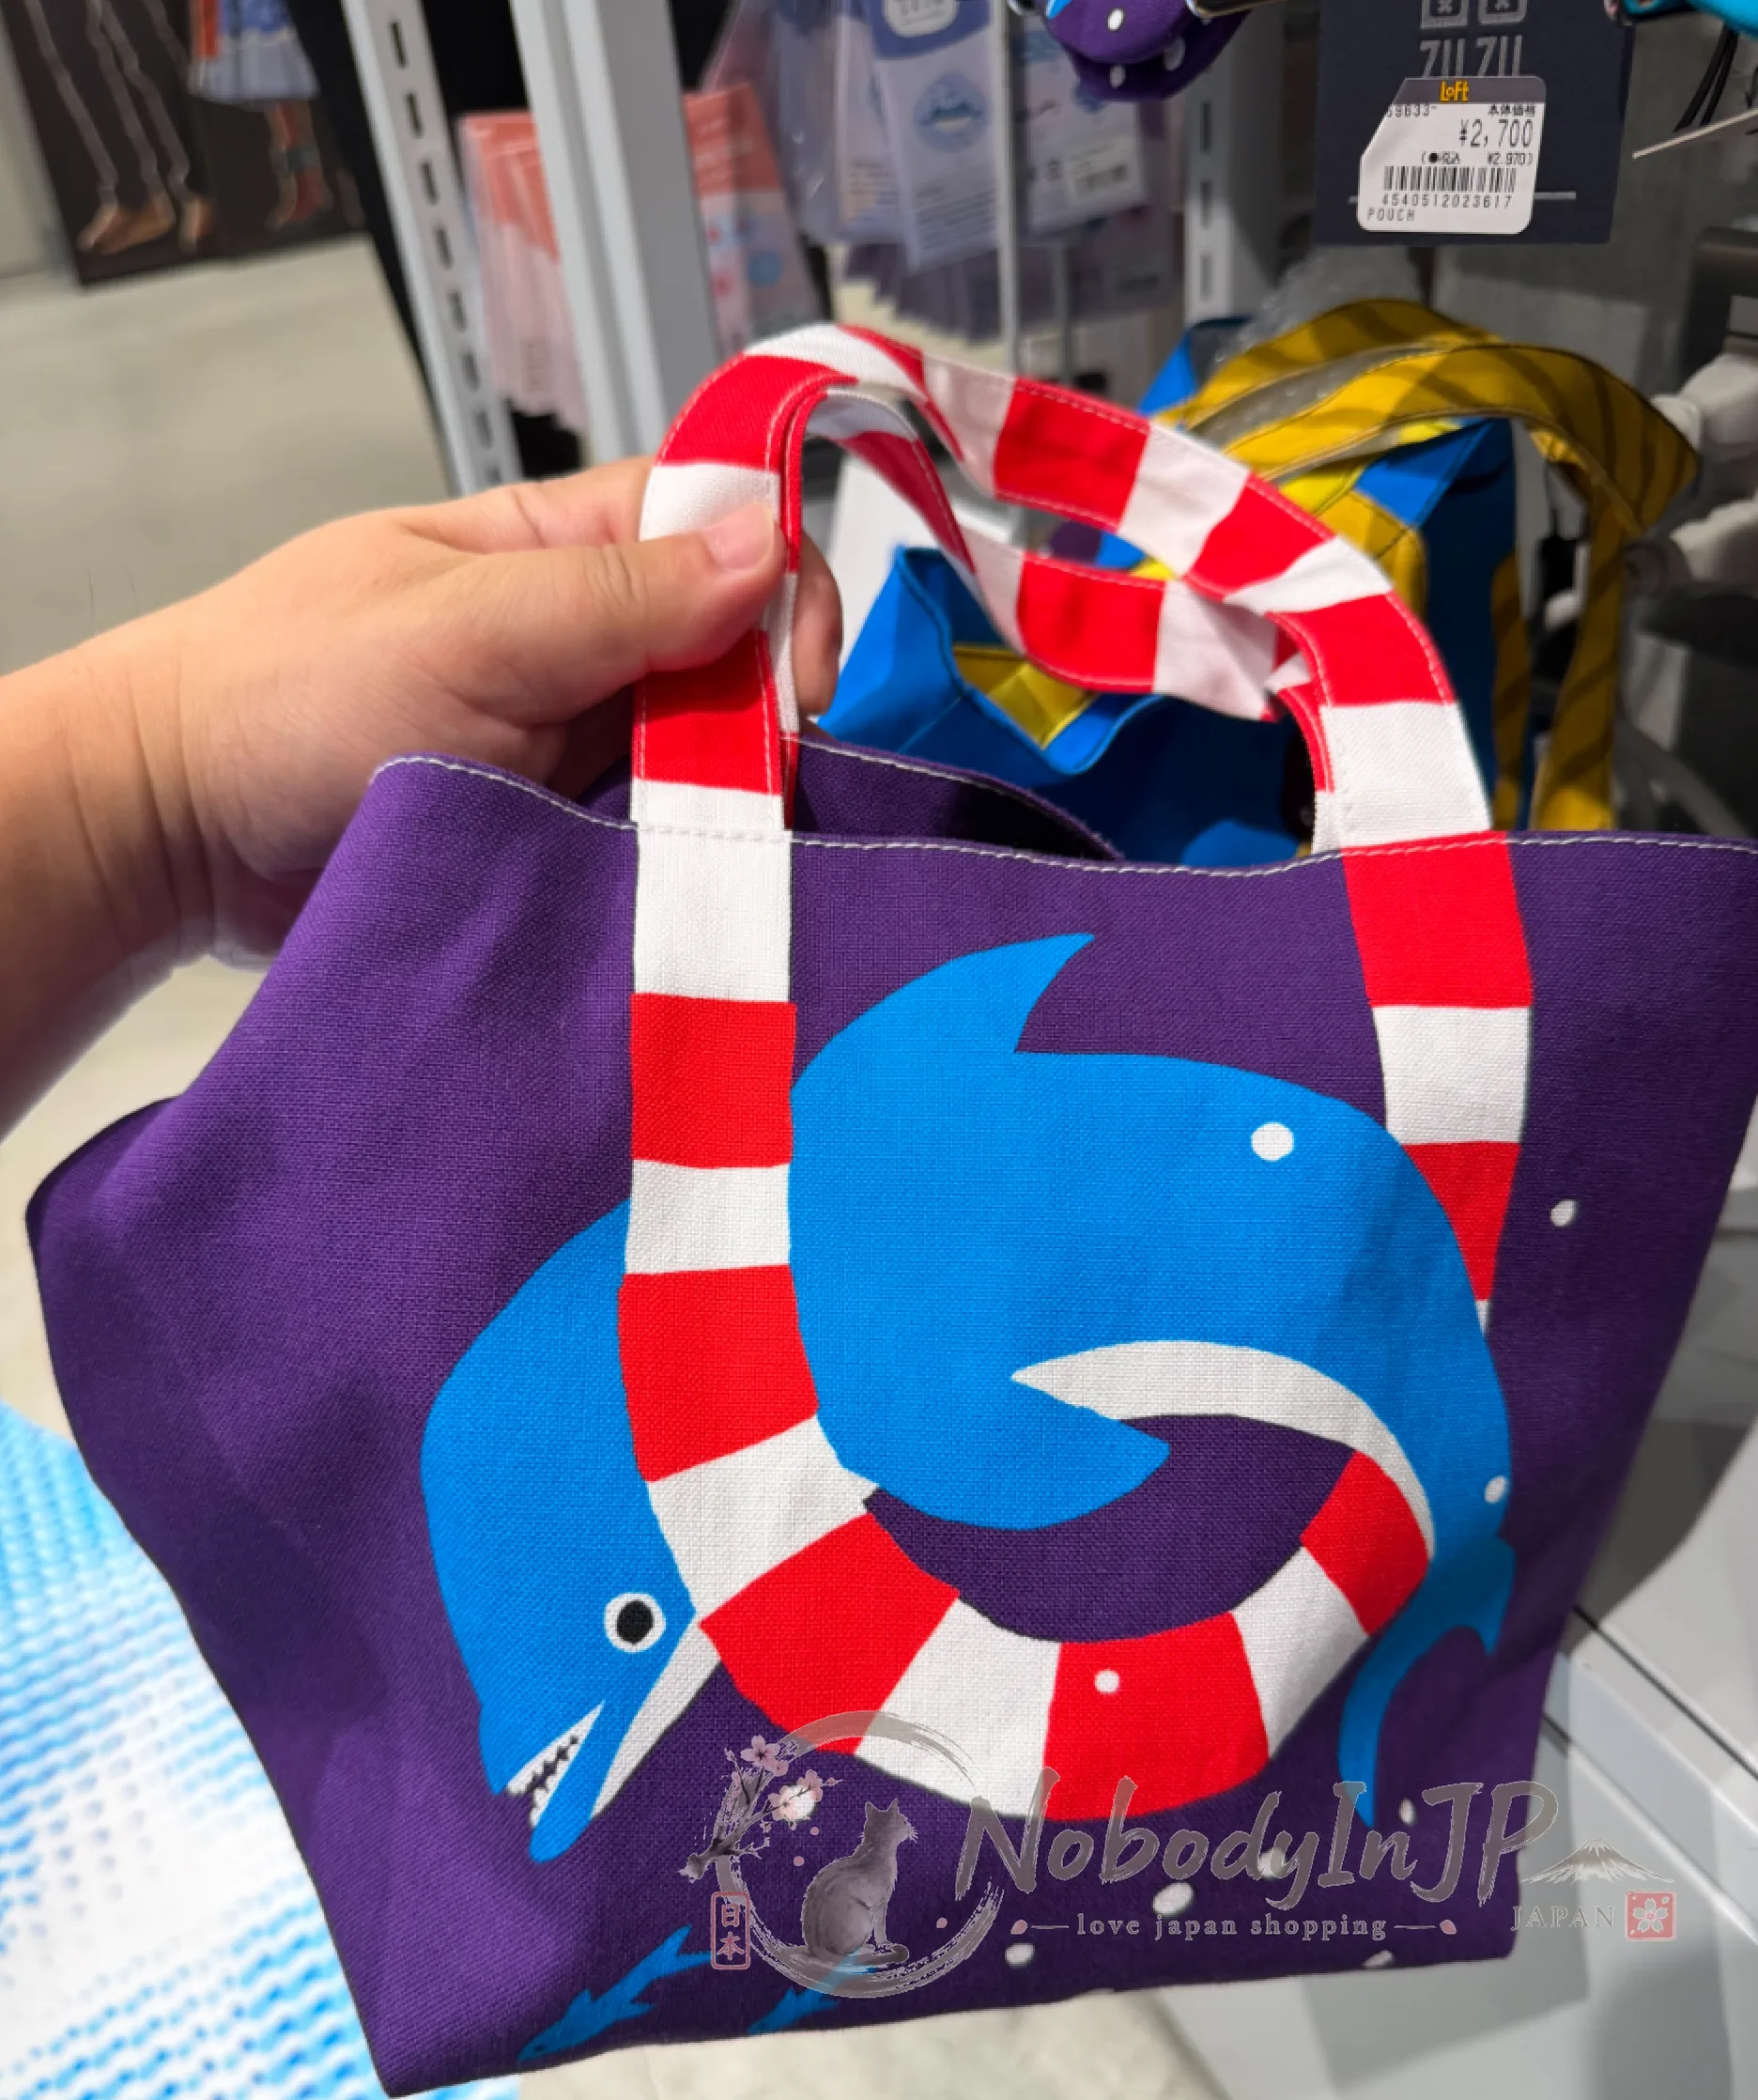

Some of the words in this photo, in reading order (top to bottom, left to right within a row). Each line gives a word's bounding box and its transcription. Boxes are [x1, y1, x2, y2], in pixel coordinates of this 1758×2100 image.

[1440, 80, 1469, 101] Loft
[1458, 118, 1534, 147] ¥2,700
[1366, 207, 1416, 222] POUCH
